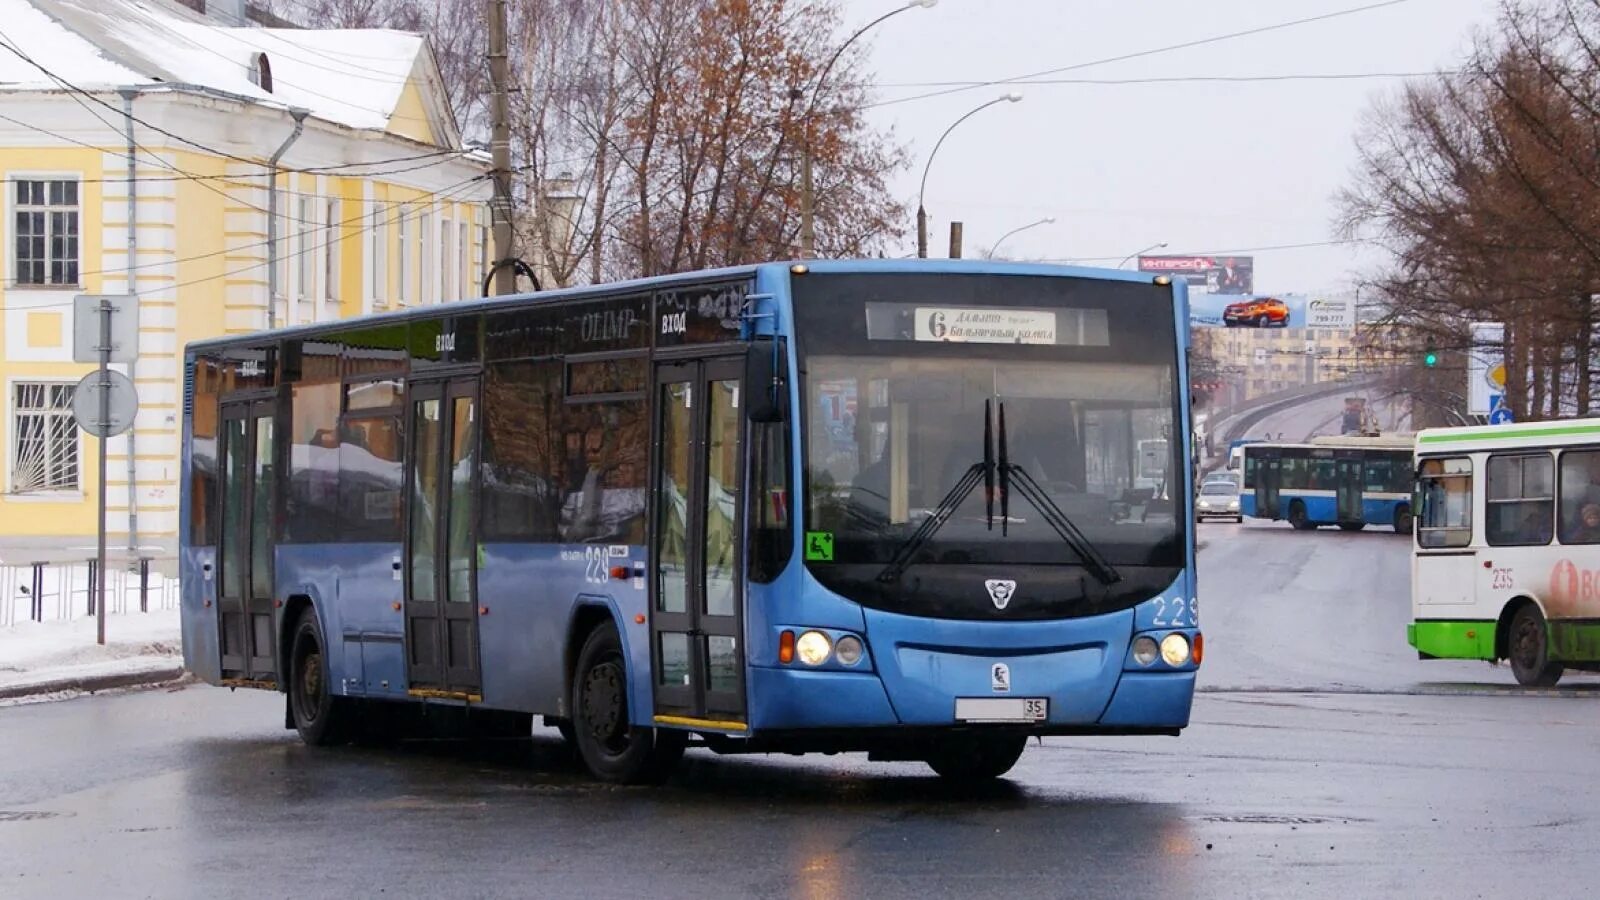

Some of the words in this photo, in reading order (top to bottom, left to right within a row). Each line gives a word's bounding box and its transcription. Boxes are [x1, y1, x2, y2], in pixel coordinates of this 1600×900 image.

[662, 311, 687, 336] ВХОД
[929, 311, 946, 338] 6
[585, 545, 609, 584] 229
[1026, 700, 1042, 713] 35
